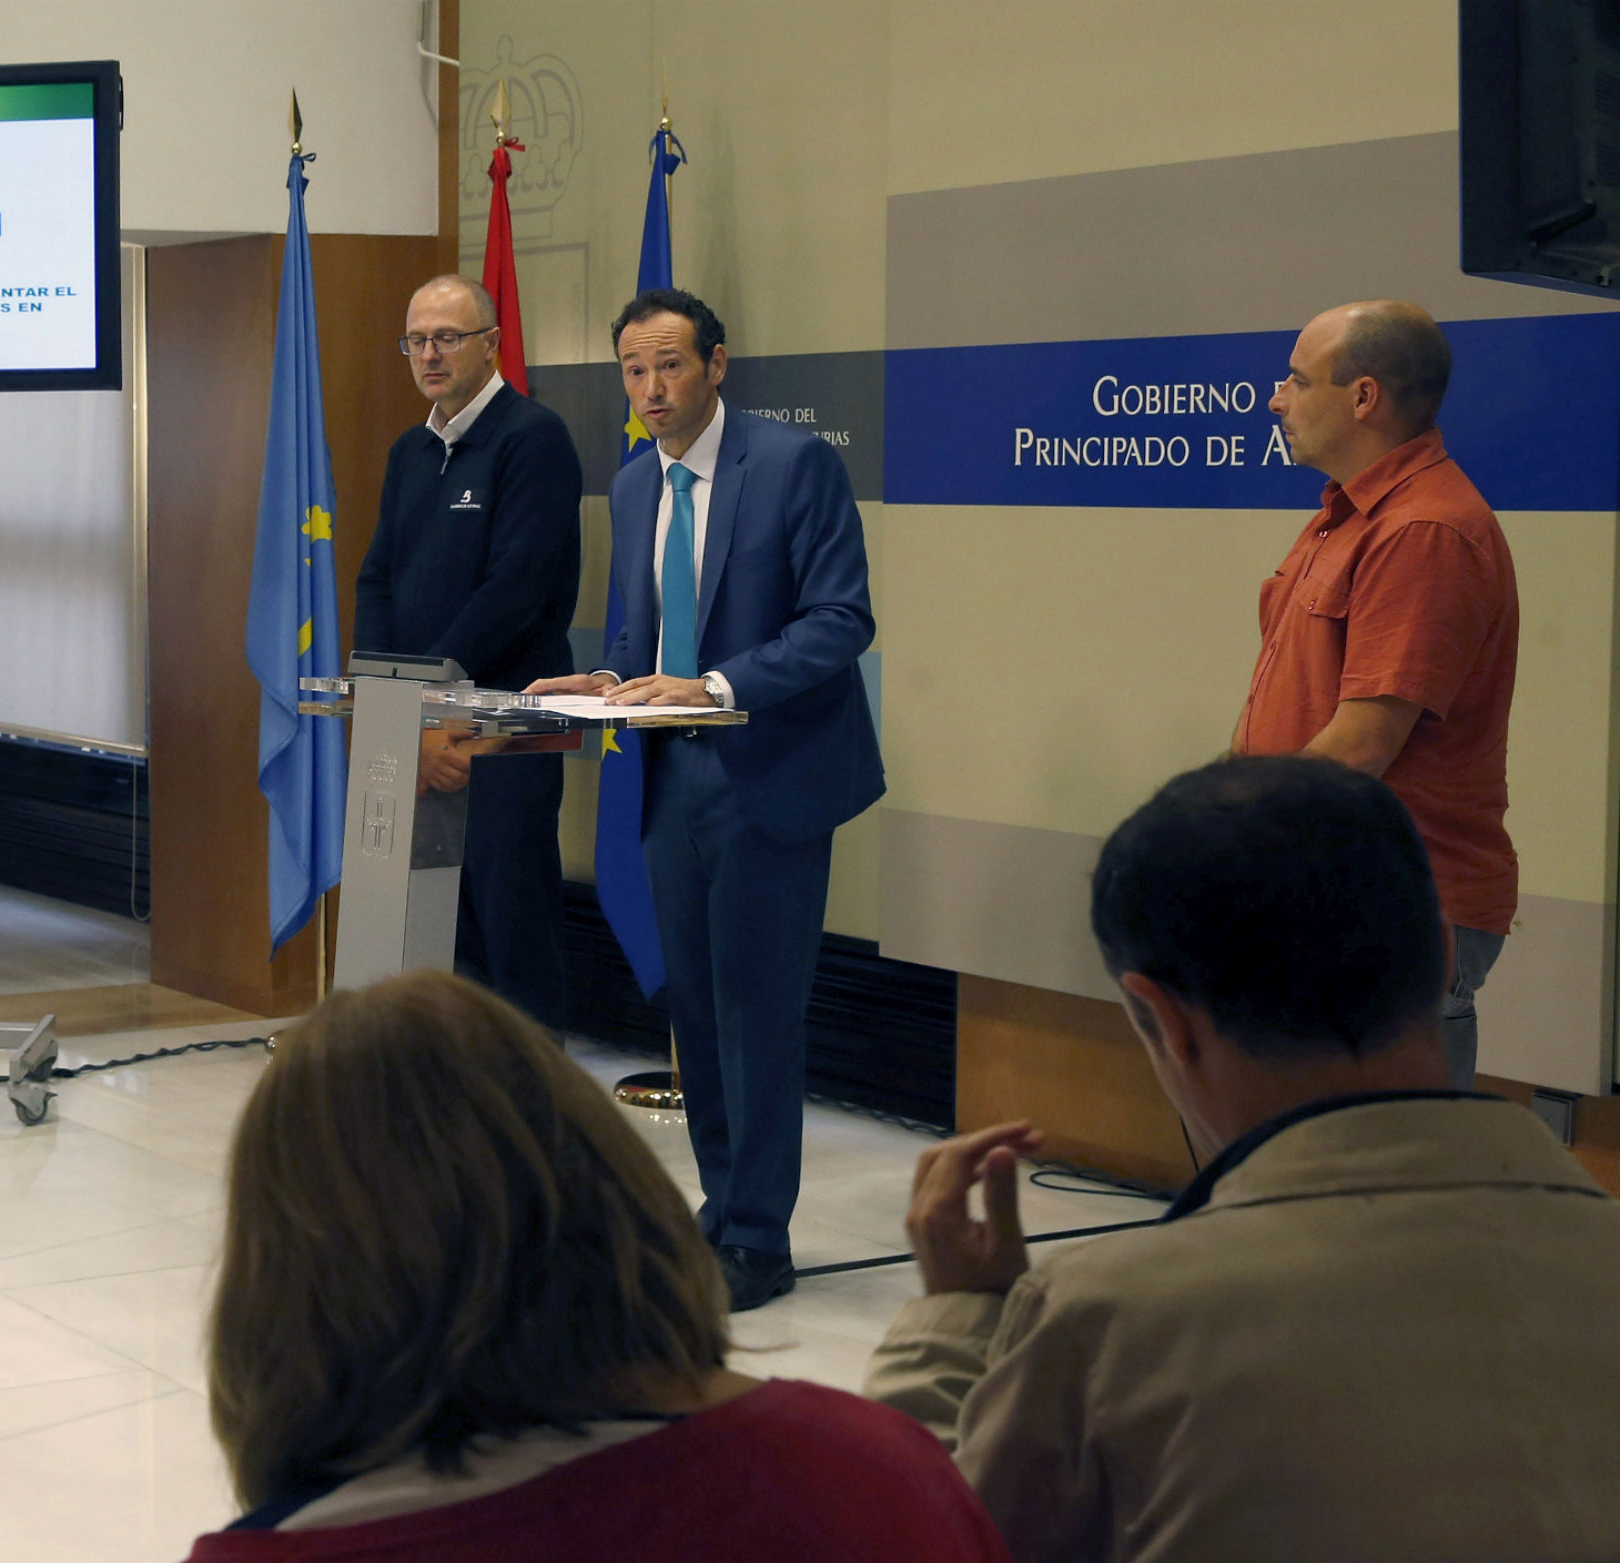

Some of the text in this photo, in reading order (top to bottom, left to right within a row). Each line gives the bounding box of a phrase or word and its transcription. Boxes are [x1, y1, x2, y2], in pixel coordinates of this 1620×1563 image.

[55, 286, 77, 297] EL
[18, 302, 43, 313] EN
[1093, 375, 1256, 416] GOBIERNO
[795, 408, 817, 423] DEL
[1014, 428, 1190, 466] PRINCIPADO
[1206, 435, 1245, 466] DE
